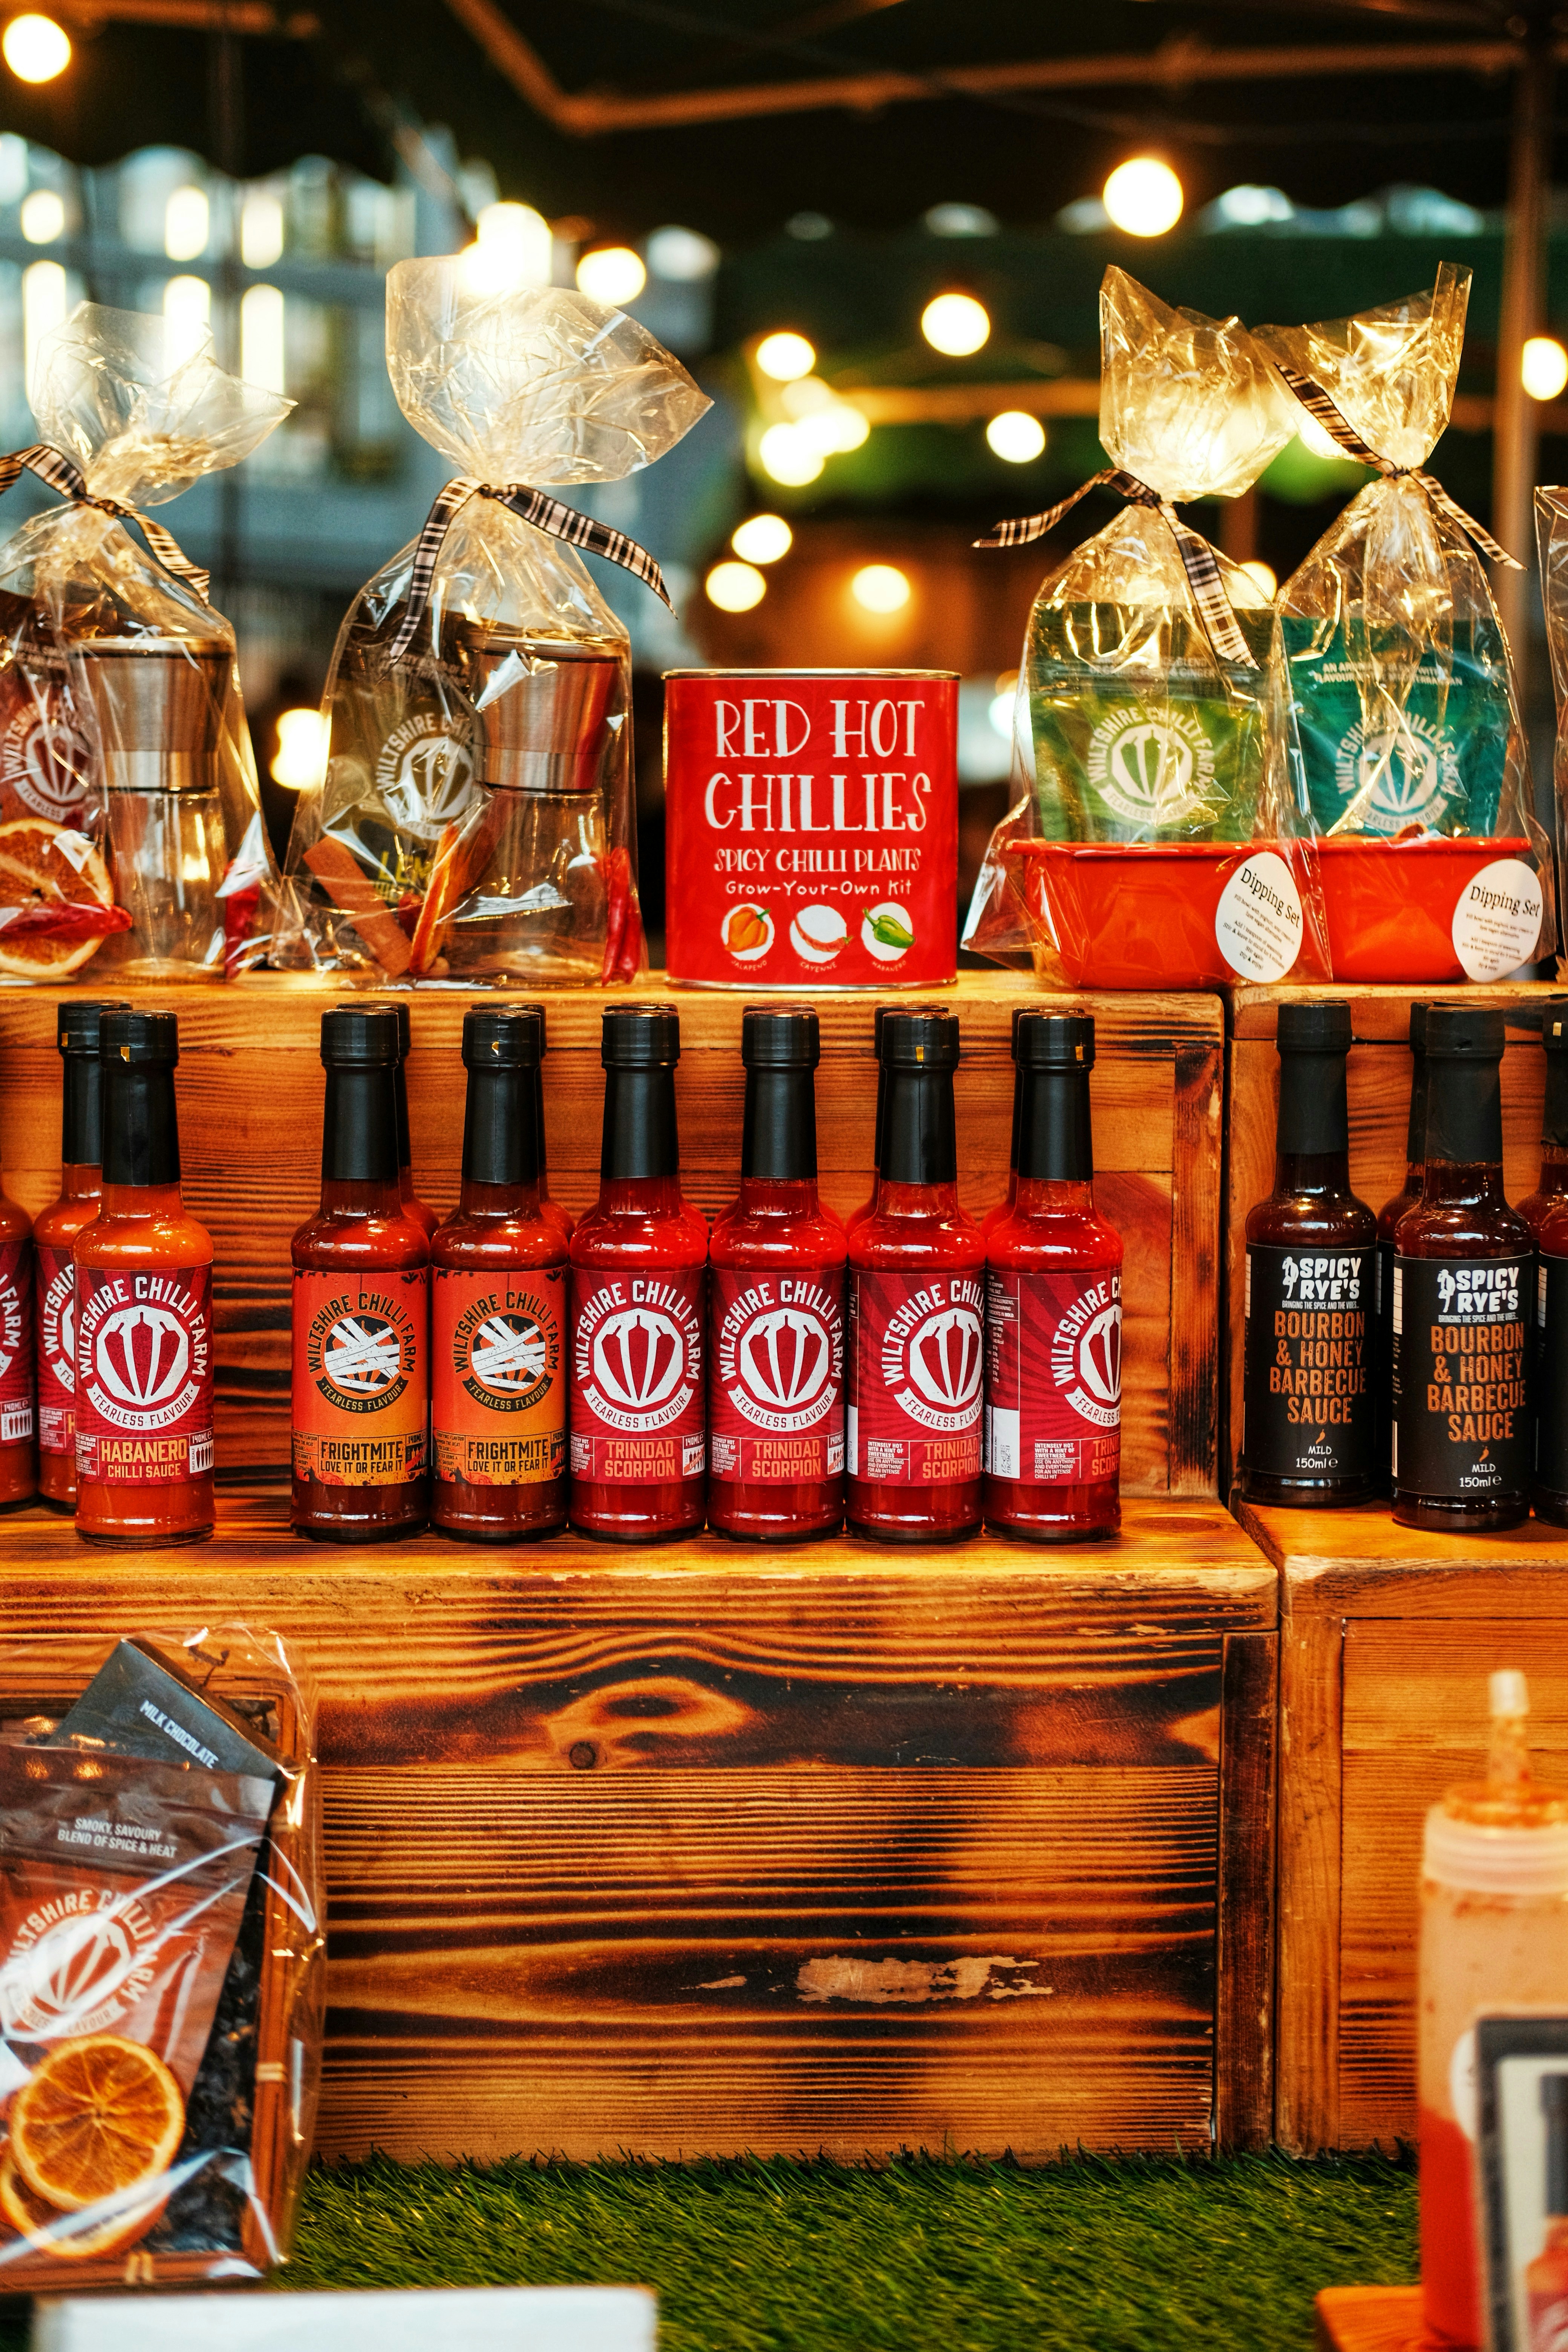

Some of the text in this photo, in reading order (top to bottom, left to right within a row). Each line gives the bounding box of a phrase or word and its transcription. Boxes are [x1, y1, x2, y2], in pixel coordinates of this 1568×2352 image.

[714, 699, 925, 758] RED HOT
[377, 712, 437, 790] WILTSHIRE
[1087, 706, 1215, 791] WILTSHIRE CHILLI FARM
[704, 772, 932, 833] CHILLIES
[714, 848, 921, 873] SPICY CHILLI PLANTS
[726, 880, 912, 896] Grow-Your-Own Kit
[1241, 868, 1300, 928] Dipping Set
[1470, 885, 1540, 917] Dipping Set
[799, 961, 837, 973] CAYENNE
[872, 960, 906, 972] HABANERO
[1299, 1257, 1362, 1279] SPICY
[1455, 1266, 1519, 1291] SPICY
[1300, 1279, 1360, 1300] RYE'S
[1457, 1289, 1519, 1314] RYE'S
[0, 1285, 21, 1348] FARM
[1282, 1300, 1303, 1309] BRINGING
[1304, 1302, 1313, 1310] THE
[1314, 1302, 1326, 1310] SPICE
[1327, 1302, 1337, 1310] AND
[78, 1276, 208, 1380] WILTSHIRE CHILLI FARM
[307, 1292, 416, 1374] WILTSHIRE CHILLI FARM
[453, 1291, 561, 1374] WILTSHIRE CHILLI FARM
[575, 1280, 701, 1381] WILTSHIRE CHILLI FARM
[719, 1282, 775, 1382] WILTSHIRE
[780, 1280, 838, 1321] CHILLI
[829, 1317, 845, 1379] FARM
[881, 1283, 946, 1387] WILTSHIRE
[950, 1280, 985, 1321] CHILL
[1050, 1281, 1110, 1387] WILTSHIRE
[1274, 1310, 1365, 1340] BOURBON
[1430, 1322, 1525, 1355] BOURBON
[1276, 1339, 1363, 1368] & HONEY
[1269, 1367, 1367, 1396] BARBECUE
[1433, 1354, 1453, 1383] &
[1459, 1352, 1524, 1384] HONEY
[93, 1394, 144, 1428] FEARLESS
[150, 1391, 194, 1426] FLAVOUR
[322, 1384, 403, 1411] FEARLESS FLAVOUR
[469, 1382, 549, 1410] FEARLESS FLAVOUR
[1427, 1379, 1527, 1414] BARBECUE
[591, 1395, 687, 1428] FEARLESS FLAVOUR
[738, 1394, 832, 1428] FEARLESS FLAVOUR
[906, 1398, 955, 1428] FEARLESS
[1077, 1398, 1115, 1423] FEARLESS
[1287, 1396, 1353, 1425] SAUCE
[1447, 1411, 1515, 1443] SAUCE
[101, 1438, 187, 1463] HABANERO
[321, 1440, 404, 1462] FRIGHTMITE
[468, 1438, 549, 1460] FRIGHTMITE
[606, 1440, 674, 1459] TRINIDAD
[753, 1439, 821, 1459] TRINIDAD
[924, 1437, 978, 1460] TRINIDAD
[1093, 1435, 1121, 1456] TRINI
[1308, 1445, 1332, 1456] MILD
[107, 1463, 181, 1478] CHILLI SAUCE
[321, 1459, 341, 1473] LOVE
[345, 1460, 353, 1473] IT
[356, 1461, 368, 1473] OR
[371, 1460, 392, 1473] FEAR
[395, 1459, 403, 1472] IT
[467, 1460, 490, 1472] LOVE
[492, 1459, 501, 1472] IT
[504, 1460, 516, 1473] OR
[519, 1459, 540, 1472] FEAR
[542, 1457, 549, 1470] IT
[605, 1459, 675, 1478] SCORPION
[752, 1459, 821, 1478] SCORPION
[922, 1457, 979, 1479] SCORPION
[1295, 1457, 1327, 1469] 150ml
[1472, 1463, 1496, 1473] MILD
[1459, 1476, 1491, 1488] 150ml
[139, 1699, 219, 1769] MILK CHOCOLATE
[75, 1817, 161, 1841] SMOKY, SAVOURY
[57, 1829, 177, 1858] BLEND OF SPICE & HEAT
[2, 1890, 92, 1972] ILTSHIRE
